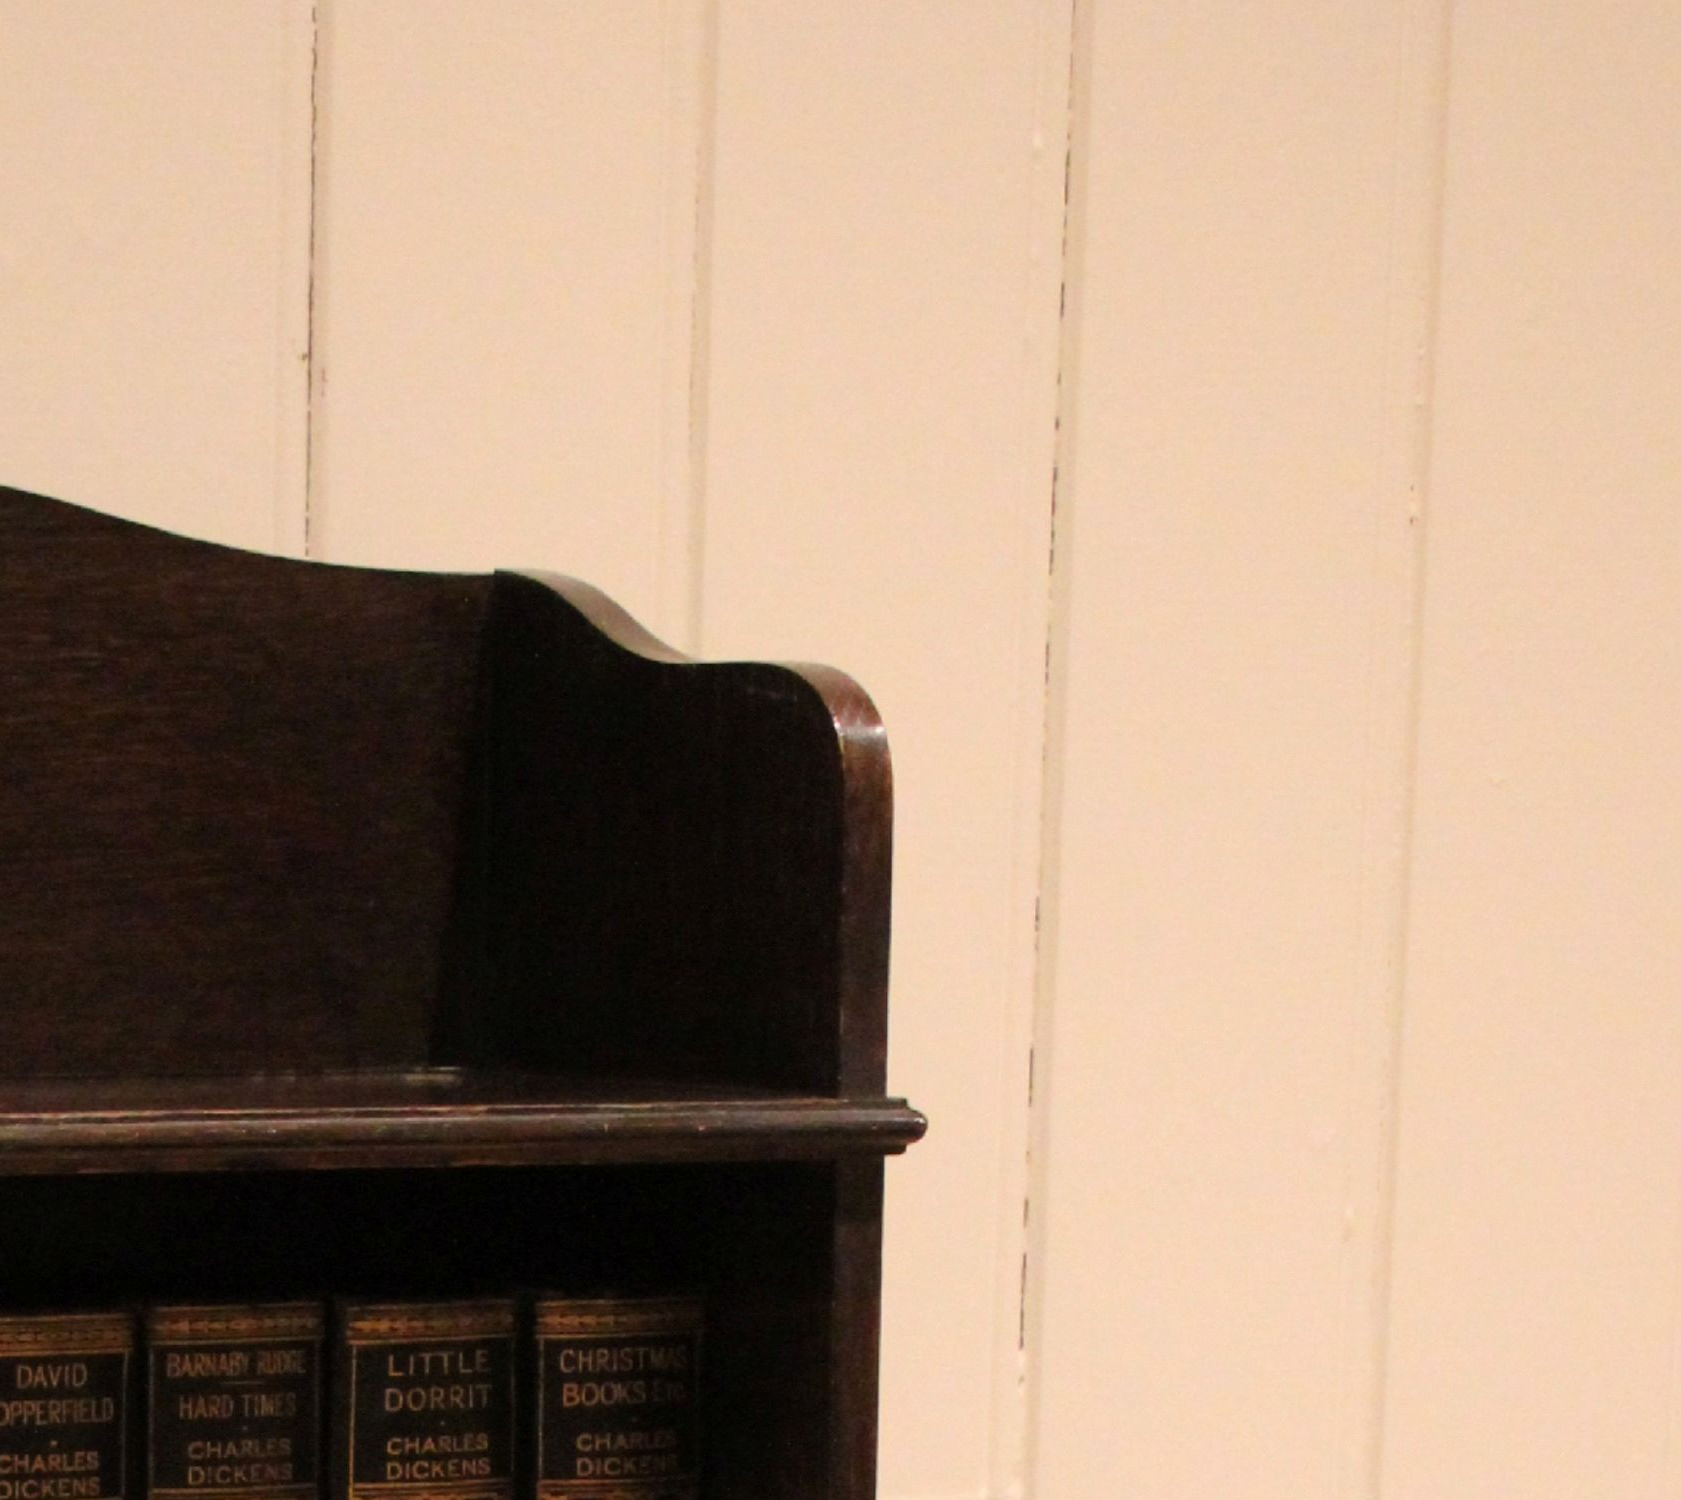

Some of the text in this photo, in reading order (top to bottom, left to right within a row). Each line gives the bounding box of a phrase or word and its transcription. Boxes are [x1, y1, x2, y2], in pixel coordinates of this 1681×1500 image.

[16, 1362, 88, 1390] DAVID
[386, 1349, 492, 1377] LITTLE
[178, 1391, 297, 1420] HARD TIMES
[383, 1383, 494, 1412] DORRIT
[562, 1380, 647, 1408] BOOKS
[187, 1438, 293, 1460] CHARLES
[385, 1432, 489, 1456] CHARLES
[187, 1461, 295, 1486] DICKENS
[385, 1457, 492, 1480] DICKENS
